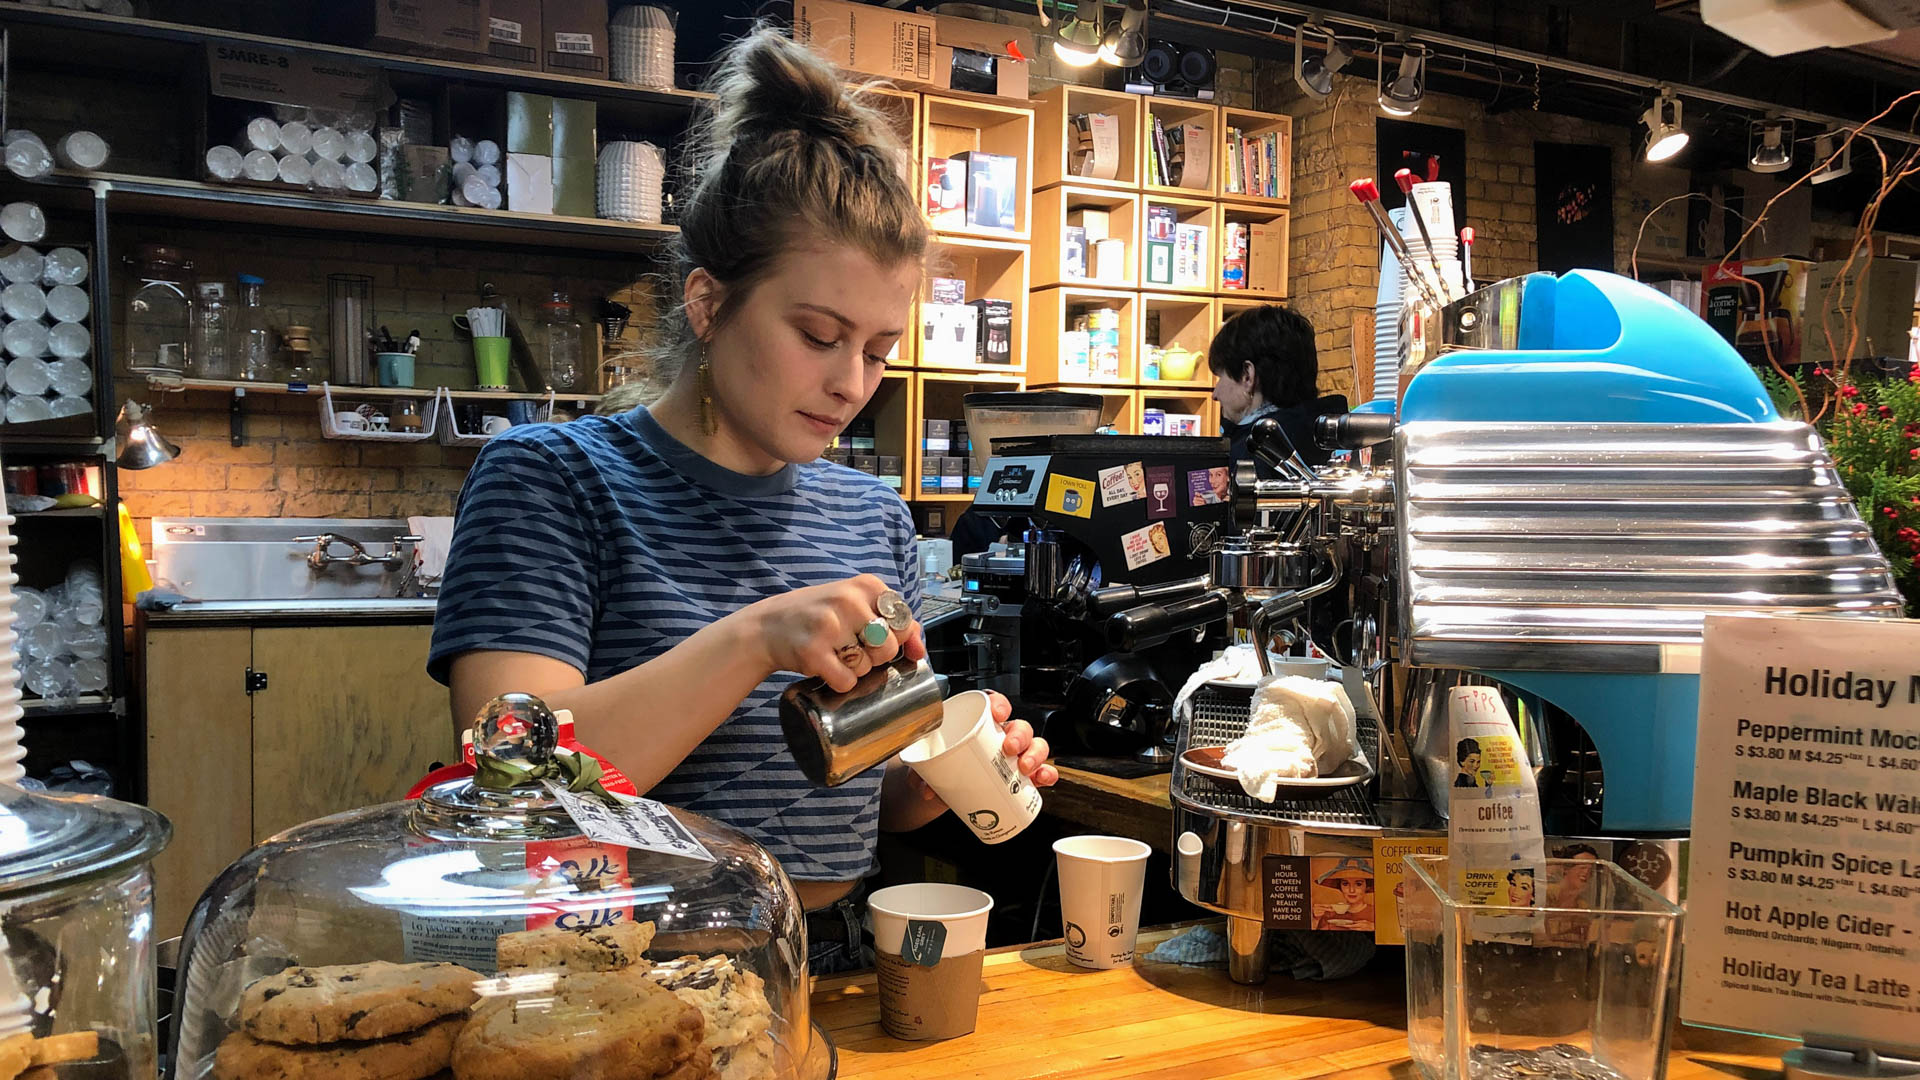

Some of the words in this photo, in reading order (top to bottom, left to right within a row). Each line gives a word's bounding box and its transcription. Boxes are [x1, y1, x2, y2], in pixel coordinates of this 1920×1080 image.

[217, 47, 289, 69] SMRE-8
[1102, 471, 1125, 490] Coffee!
[1765, 666, 1897, 709] Holiday
[1737, 718, 1864, 747] Peppermint
[1870, 728, 1920, 750] Moc
[1735, 745, 1744, 757] S
[1747, 745, 1785, 760] $3.80
[1789, 749, 1801, 761] M
[1867, 755, 1876, 768] L
[1733, 780, 1798, 805] Maple
[1806, 786, 1868, 810] Black
[1478, 803, 1513, 821] coffee
[1731, 806, 1740, 818] S
[1743, 807, 1781, 822] $3.80
[1784, 811, 1797, 824] M
[1862, 818, 1871, 831] L
[1381, 845, 1412, 857] COFFEE
[1426, 845, 1443, 855] THE
[1729, 841, 1824, 869] Pumpkin
[1831, 852, 1893, 876] Spice
[1385, 862, 1403, 874] BOS
[1466, 872, 1495, 880] DRINK
[1727, 867, 1737, 880] S
[1740, 868, 1777, 884] $3.80
[1781, 873, 1793, 886] M
[1858, 881, 1866, 894] L
[1725, 900, 1761, 922] Hot
[1768, 906, 1829, 930] Apple
[1836, 914, 1895, 937] Cider
[1723, 956, 1802, 987] Holiday
[1808, 967, 1846, 991] Tea
[1854, 973, 1910, 998] Latte
